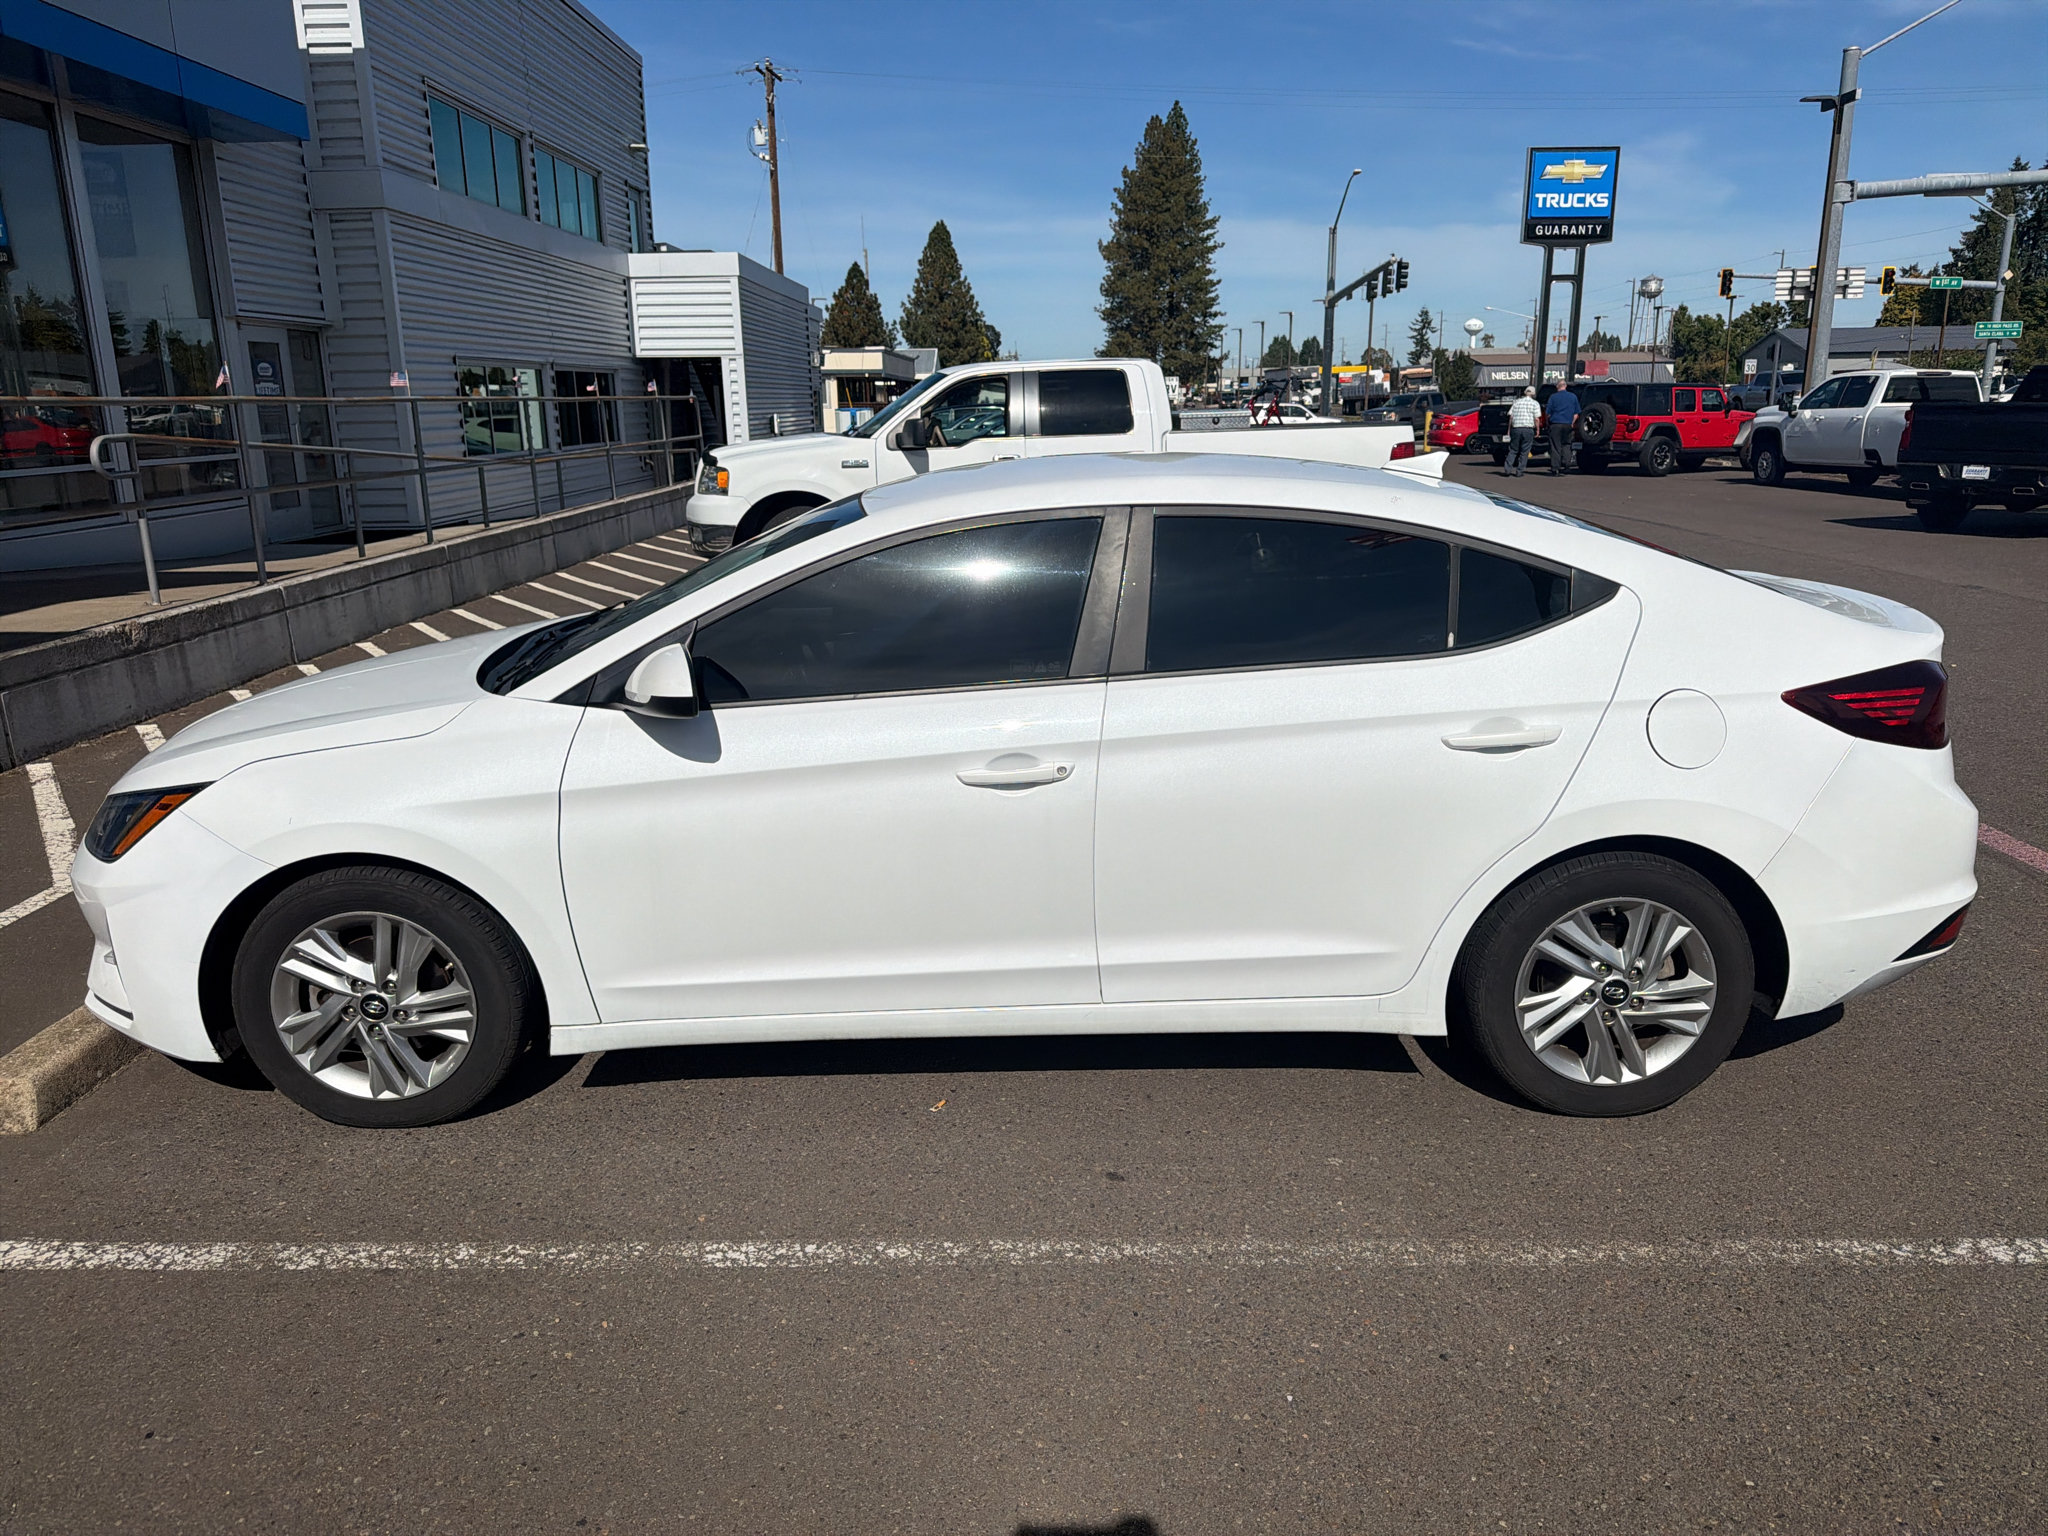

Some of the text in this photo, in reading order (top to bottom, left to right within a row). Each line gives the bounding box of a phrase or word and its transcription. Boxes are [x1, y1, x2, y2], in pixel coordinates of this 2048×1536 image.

[1535, 193, 1609, 208] TRUCKS
[1535, 224, 1603, 235] GUARANTY
[1746, 364, 1755, 373] 30
[1491, 371, 1529, 380] NIELSEN
